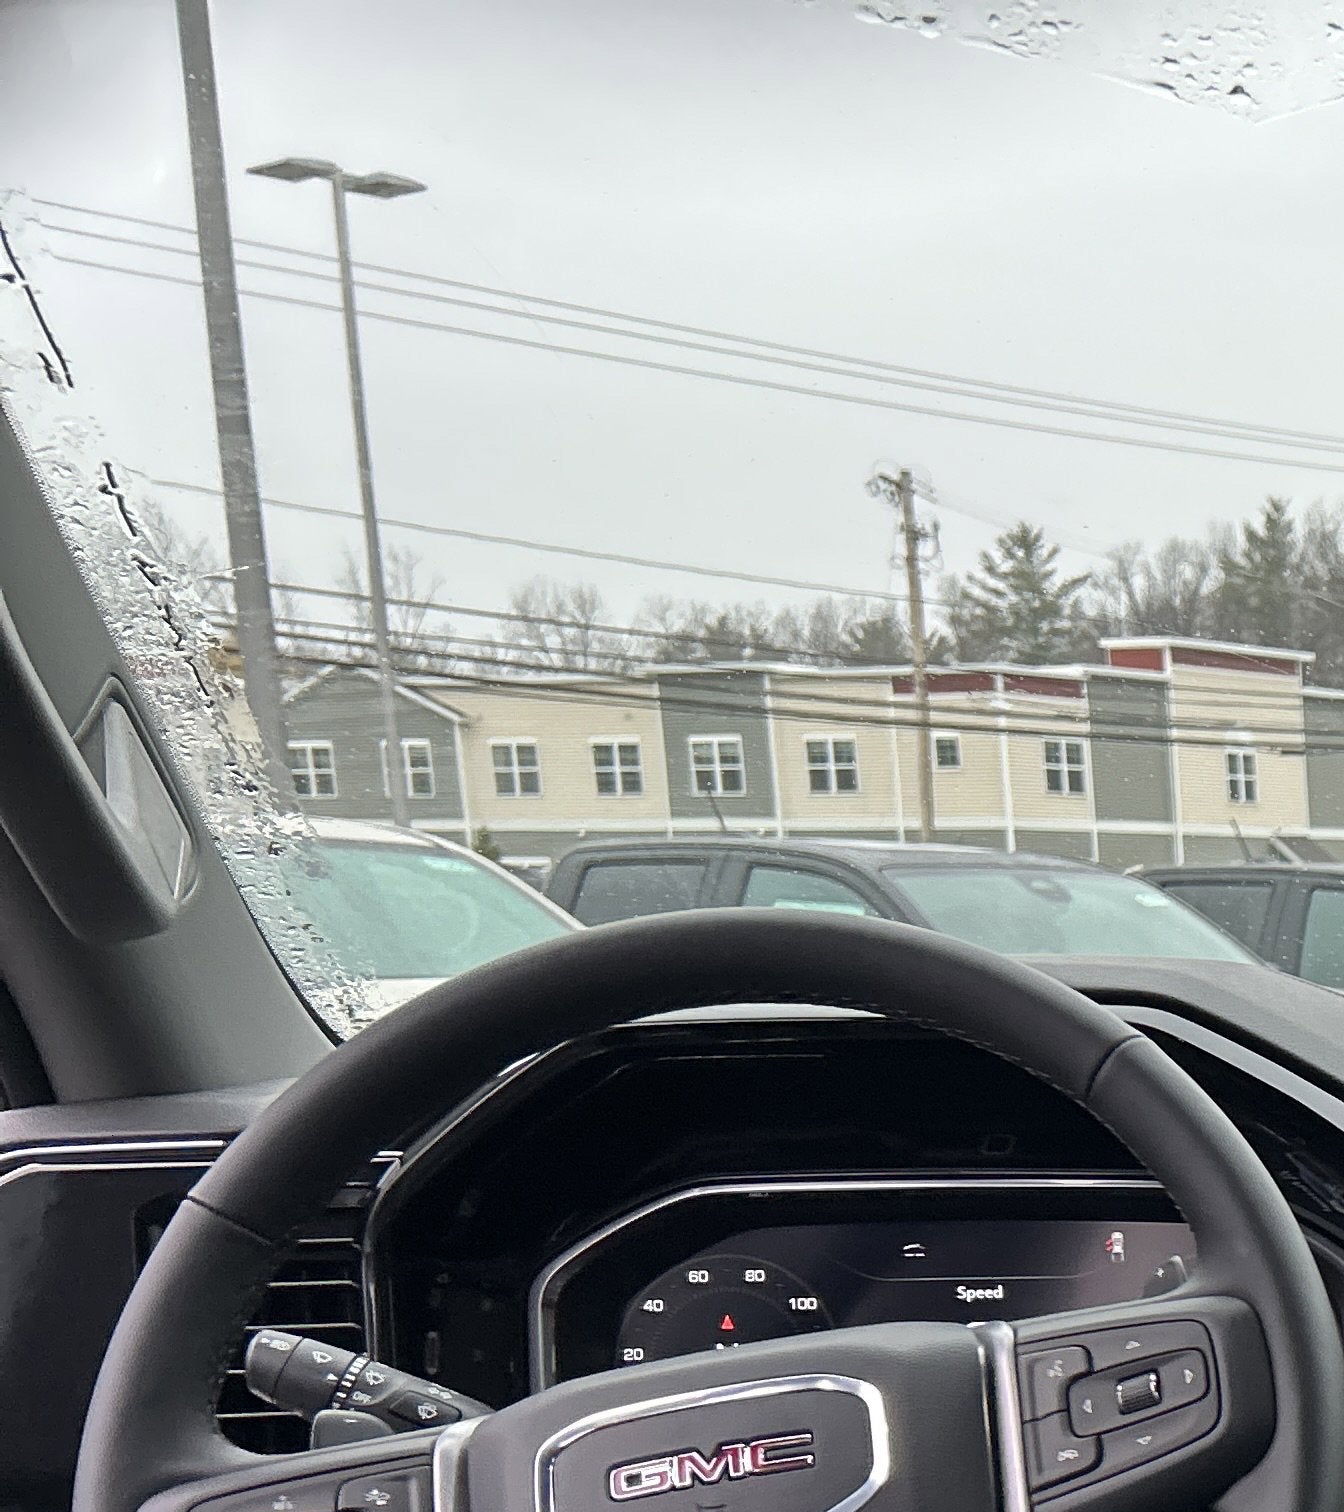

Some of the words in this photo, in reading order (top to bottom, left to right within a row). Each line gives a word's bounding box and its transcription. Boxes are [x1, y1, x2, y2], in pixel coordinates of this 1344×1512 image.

[688, 1270, 709, 1283] 60
[745, 1270, 765, 1282] 80
[956, 1285, 1003, 1302] Speed
[643, 1299, 664, 1312] 40
[789, 1297, 817, 1310] 100
[623, 1349, 644, 1361] 20
[609, 1433, 815, 1500] GMC
